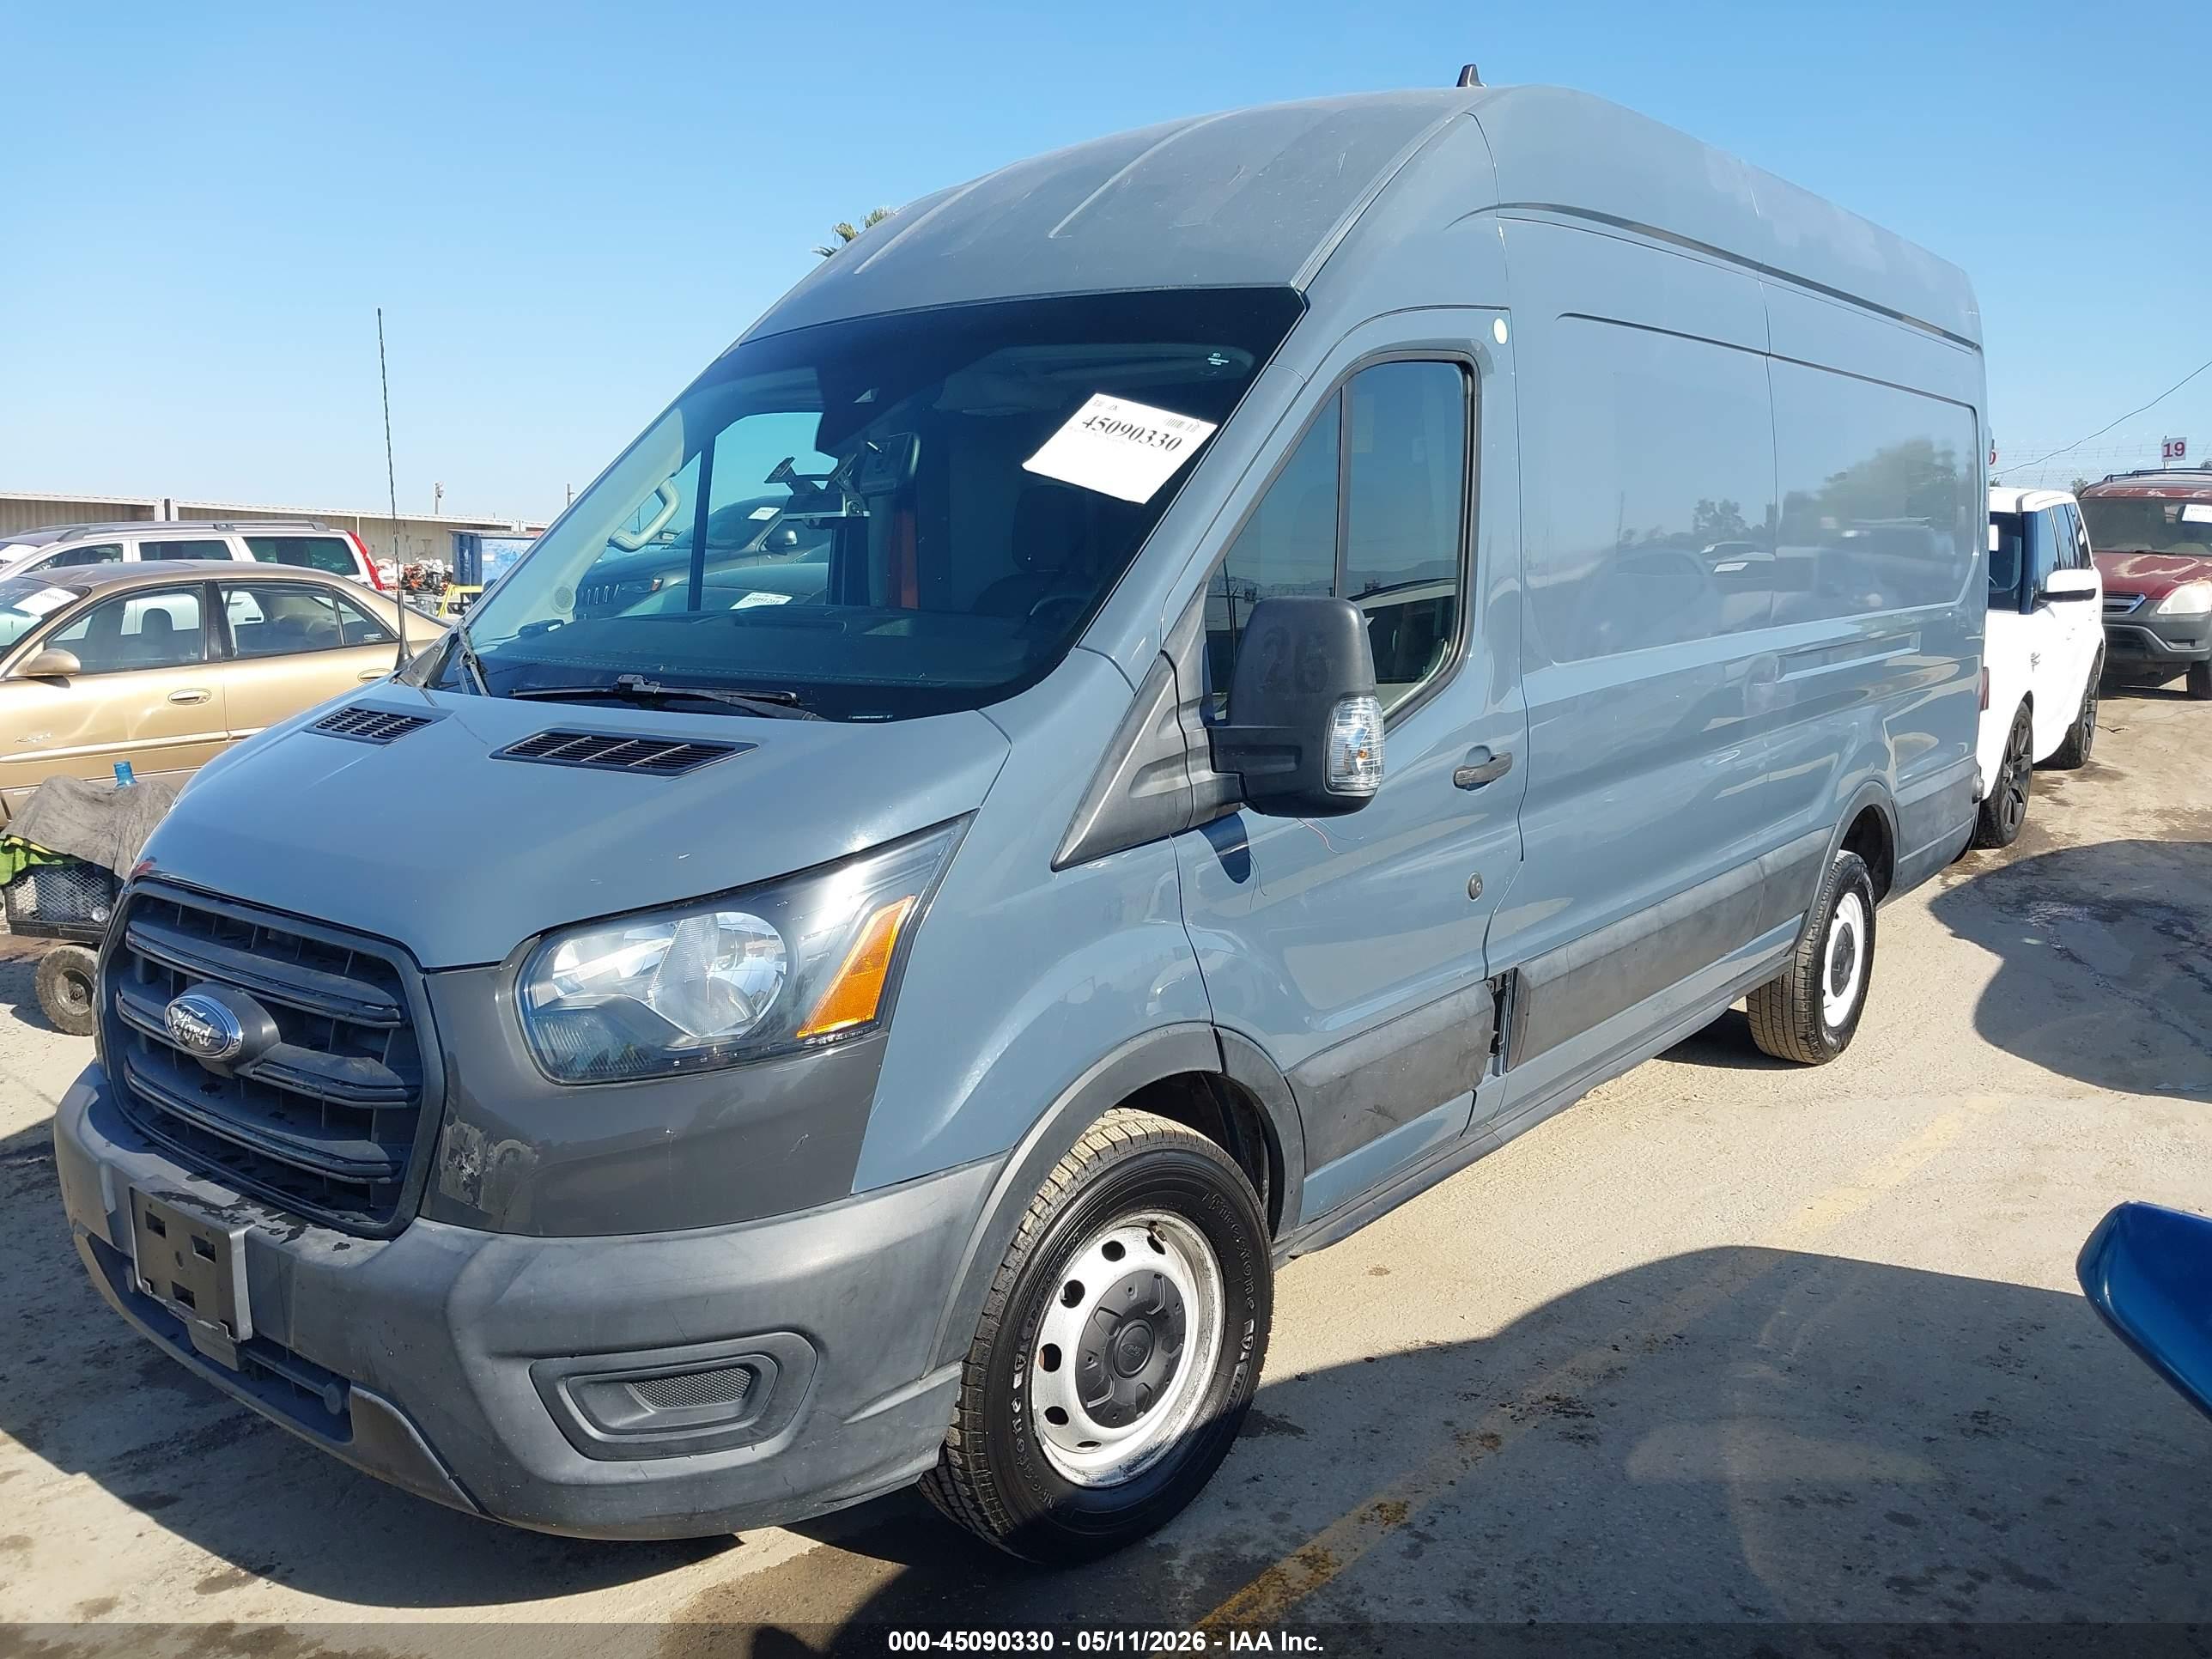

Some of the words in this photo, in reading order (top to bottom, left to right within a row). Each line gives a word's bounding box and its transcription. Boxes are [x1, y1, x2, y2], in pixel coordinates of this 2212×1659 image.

[1082, 414, 1182, 453] 45090330
[2163, 441, 2185, 458] 19
[1208, 1193, 1256, 1311] Firestone
[1010, 1396, 1058, 1511] irestone
